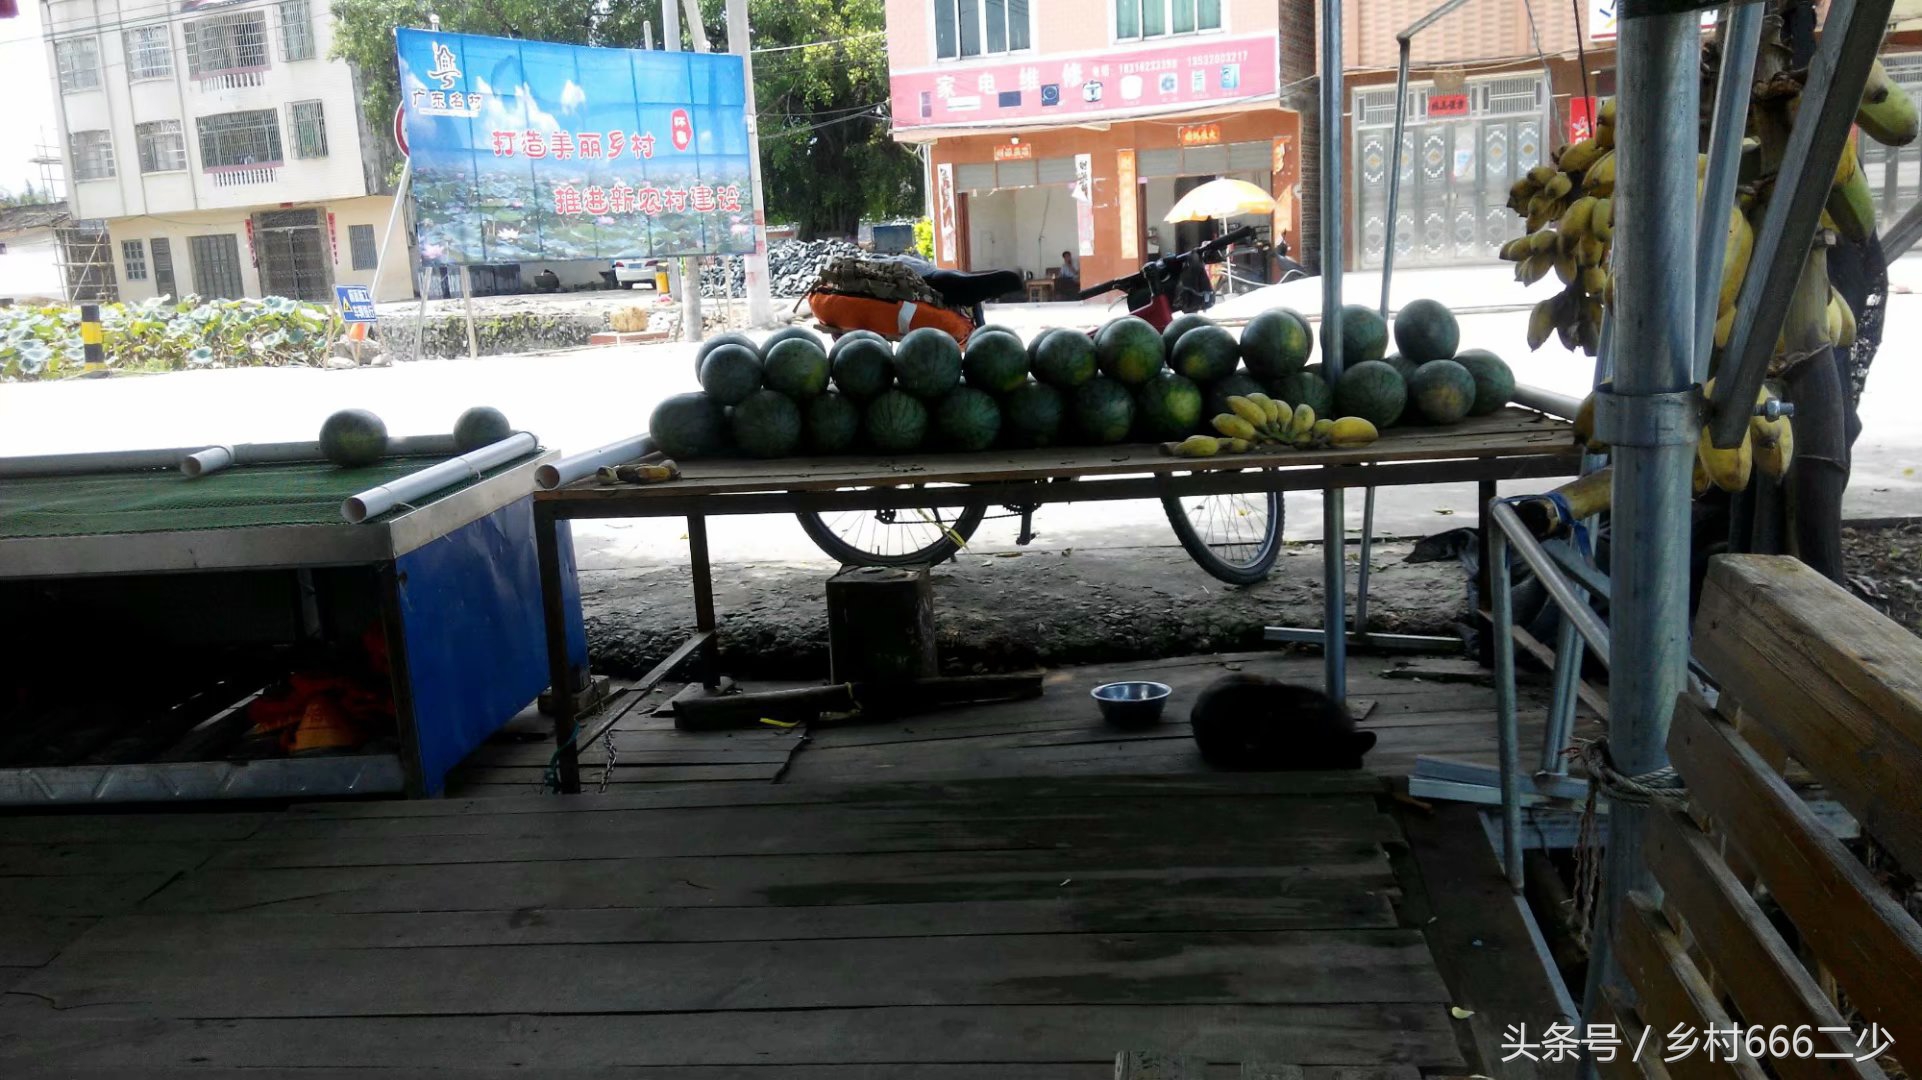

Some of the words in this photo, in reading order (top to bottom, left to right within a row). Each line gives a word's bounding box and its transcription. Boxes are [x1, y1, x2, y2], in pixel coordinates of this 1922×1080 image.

[935, 62, 1084, 98] 家电维修
[412, 90, 482, 111] 广东名村
[491, 130, 656, 160] 打造美丽乡村
[554, 184, 742, 215] 推进新农村建设
